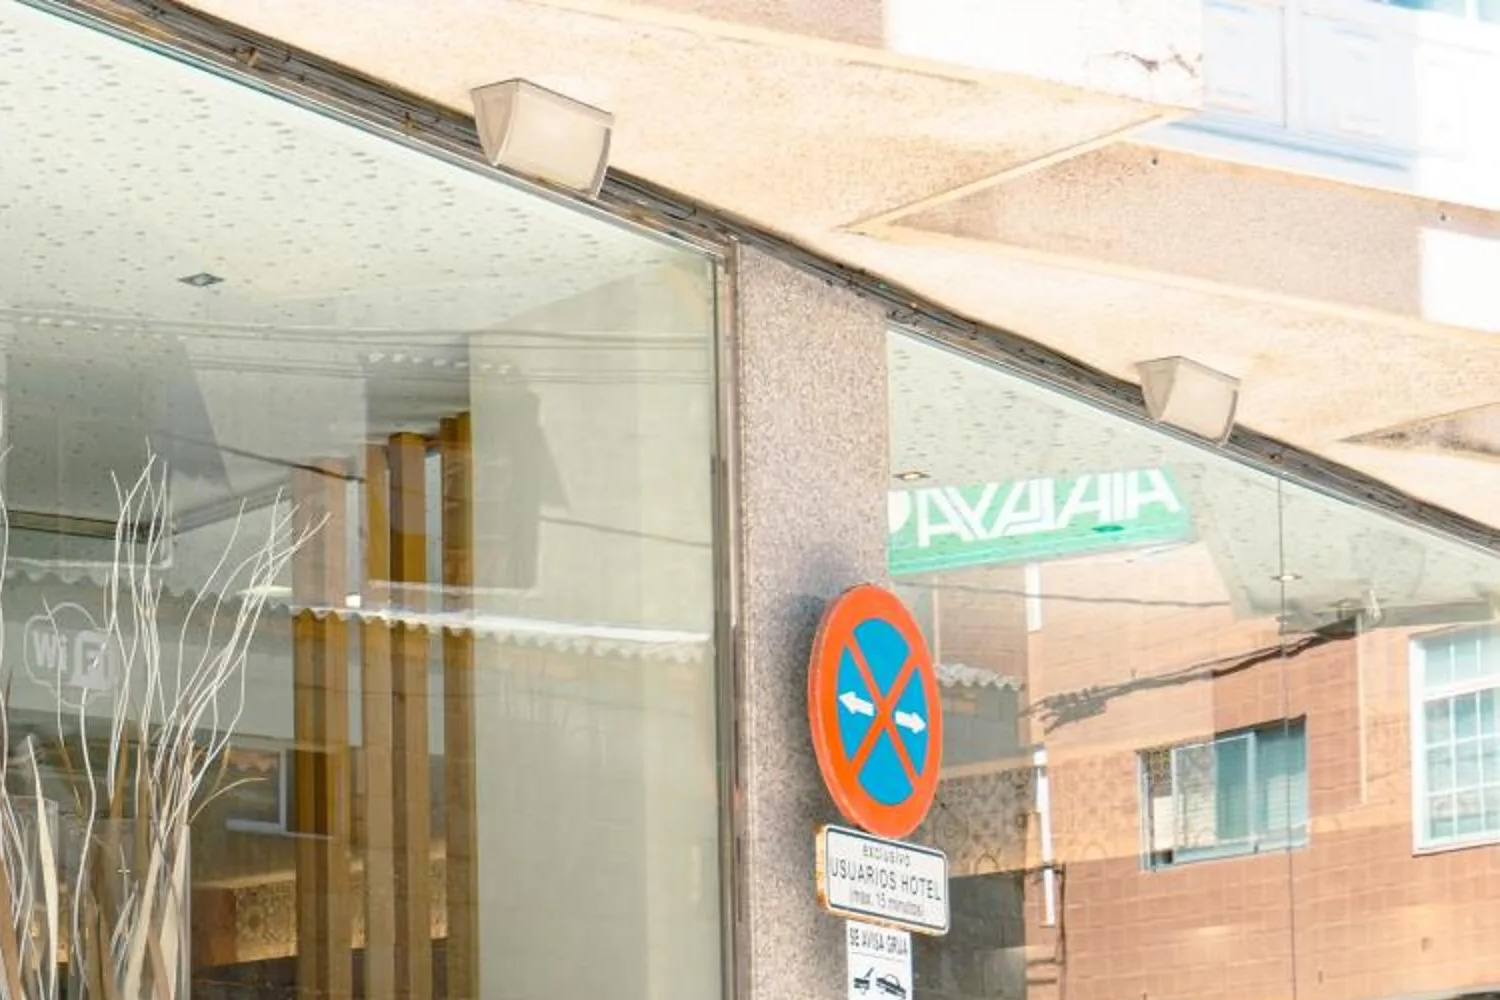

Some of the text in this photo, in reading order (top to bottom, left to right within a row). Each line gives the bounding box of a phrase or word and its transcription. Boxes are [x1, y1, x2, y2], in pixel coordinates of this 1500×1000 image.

[831, 858, 942, 901] USUARIOS HOTEL
[849, 927, 860, 947] SE
